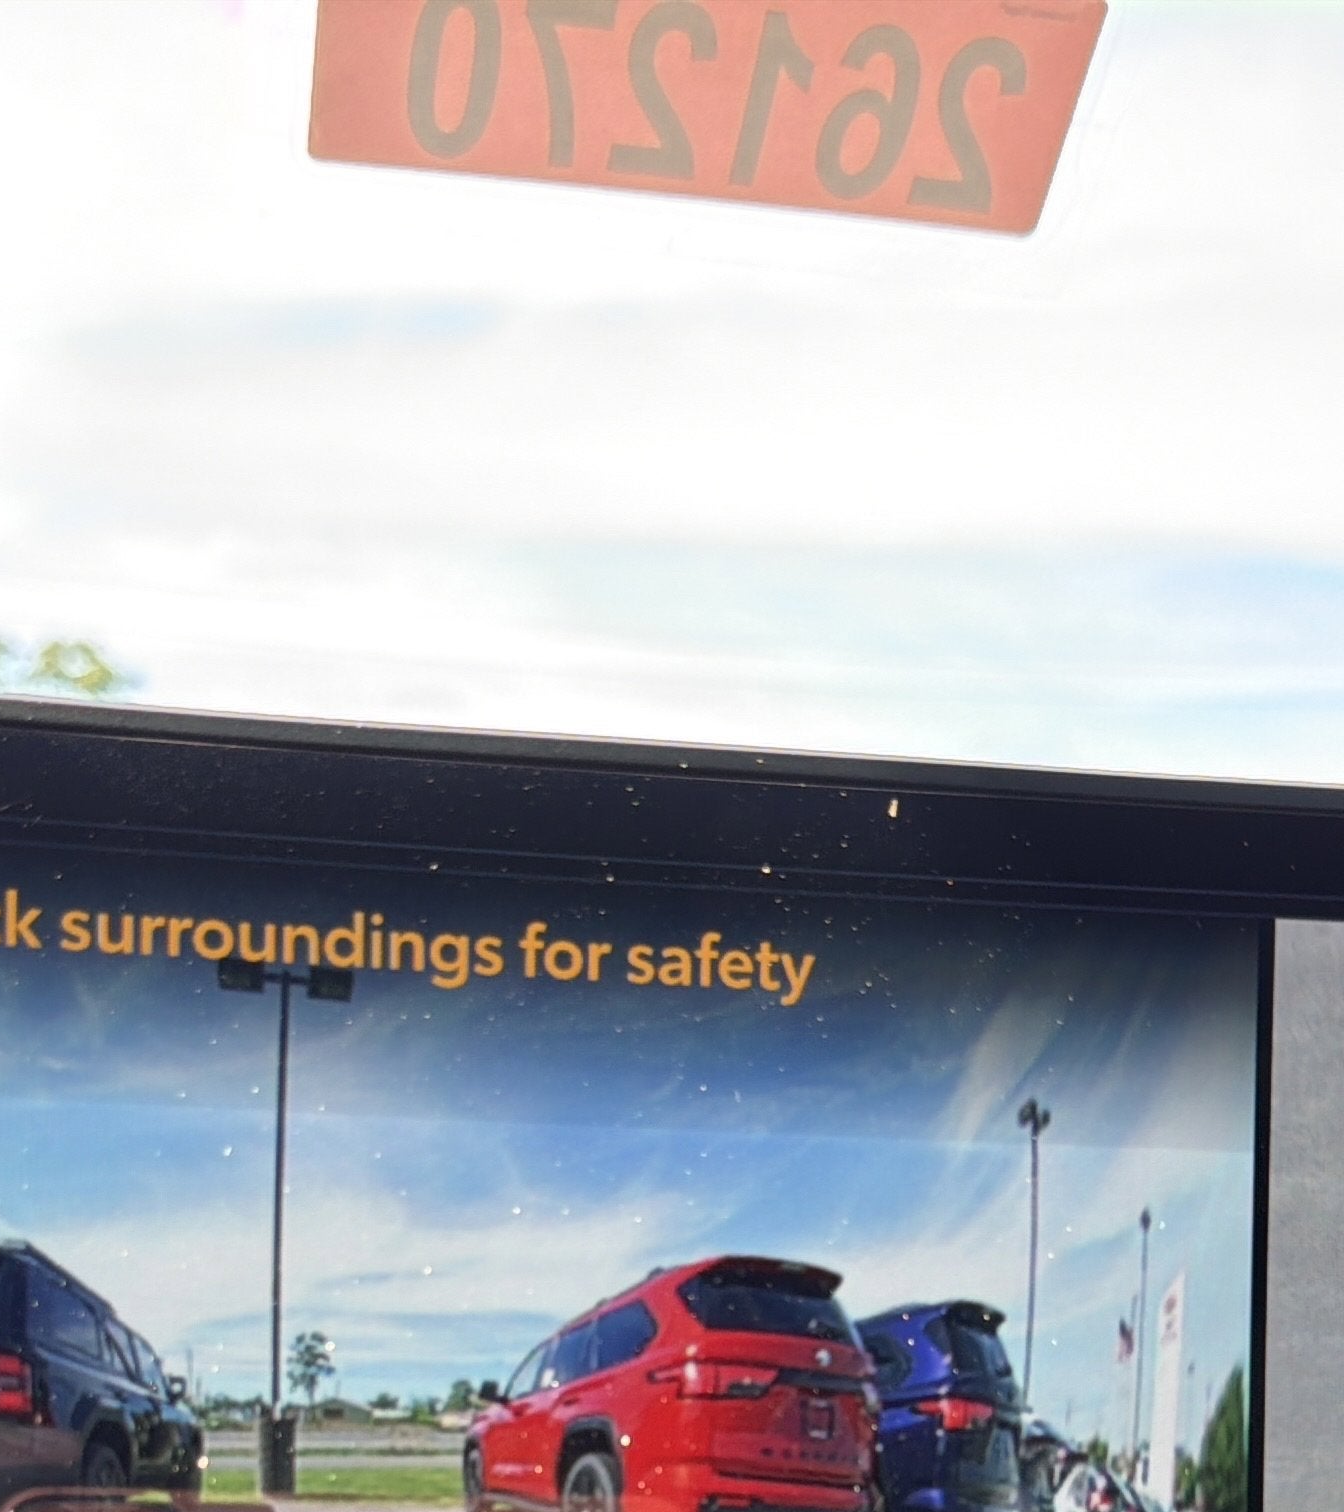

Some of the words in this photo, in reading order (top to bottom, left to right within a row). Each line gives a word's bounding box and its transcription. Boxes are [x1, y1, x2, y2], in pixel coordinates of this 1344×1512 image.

[58, 910, 506, 989] surroundings
[519, 921, 612, 983] for
[626, 933, 817, 1006] safety
